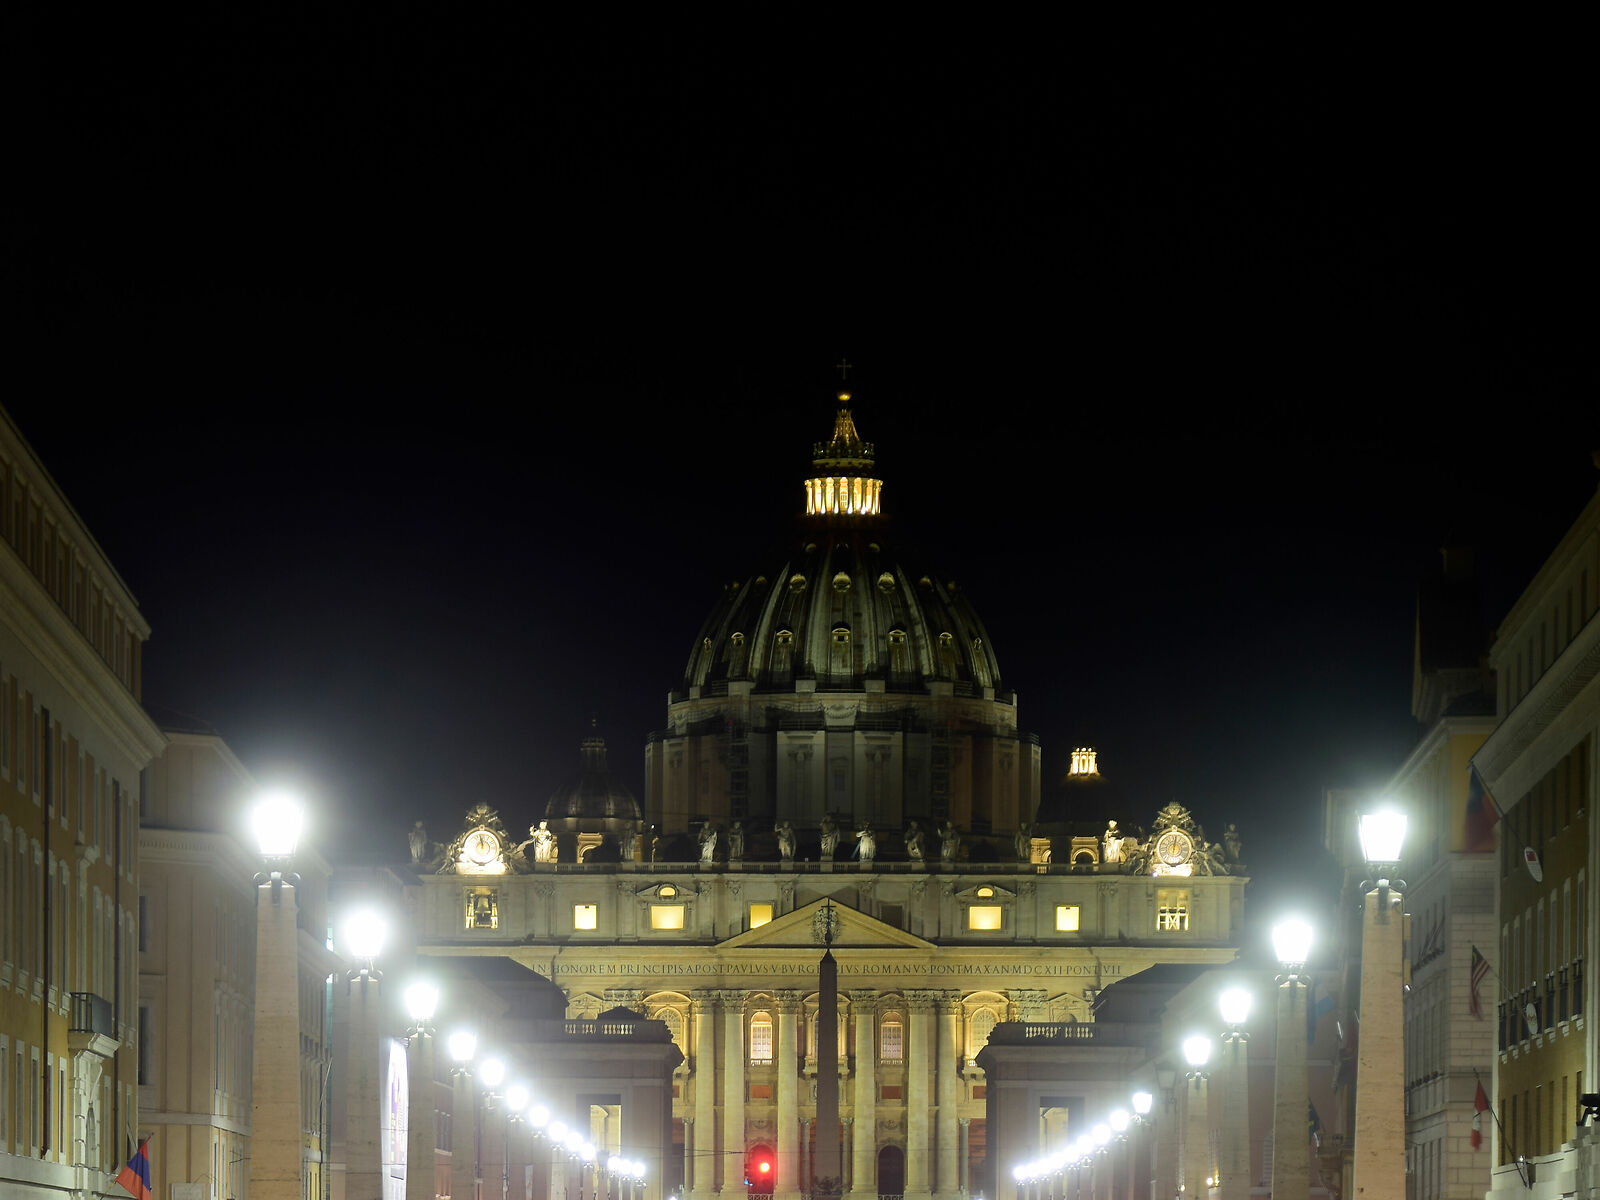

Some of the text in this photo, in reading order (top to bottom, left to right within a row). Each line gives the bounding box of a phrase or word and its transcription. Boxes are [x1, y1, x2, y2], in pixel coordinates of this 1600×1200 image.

[552, 964, 616, 974] HONOREM
[620, 964, 683, 974] PRINCIPIS
[686, 964, 724, 974] APOST
[727, 964, 768, 974] PAVLVS
[771, 964, 778, 974] V
[863, 964, 927, 974] ROMANVS
[930, 964, 963, 974] PONT
[963, 964, 990, 974] MAX
[992, 964, 1010, 974] AN
[1012, 964, 1062, 974] MDCXII
[1066, 964, 1099, 974] PONT
[1103, 965, 1120, 975] VII
